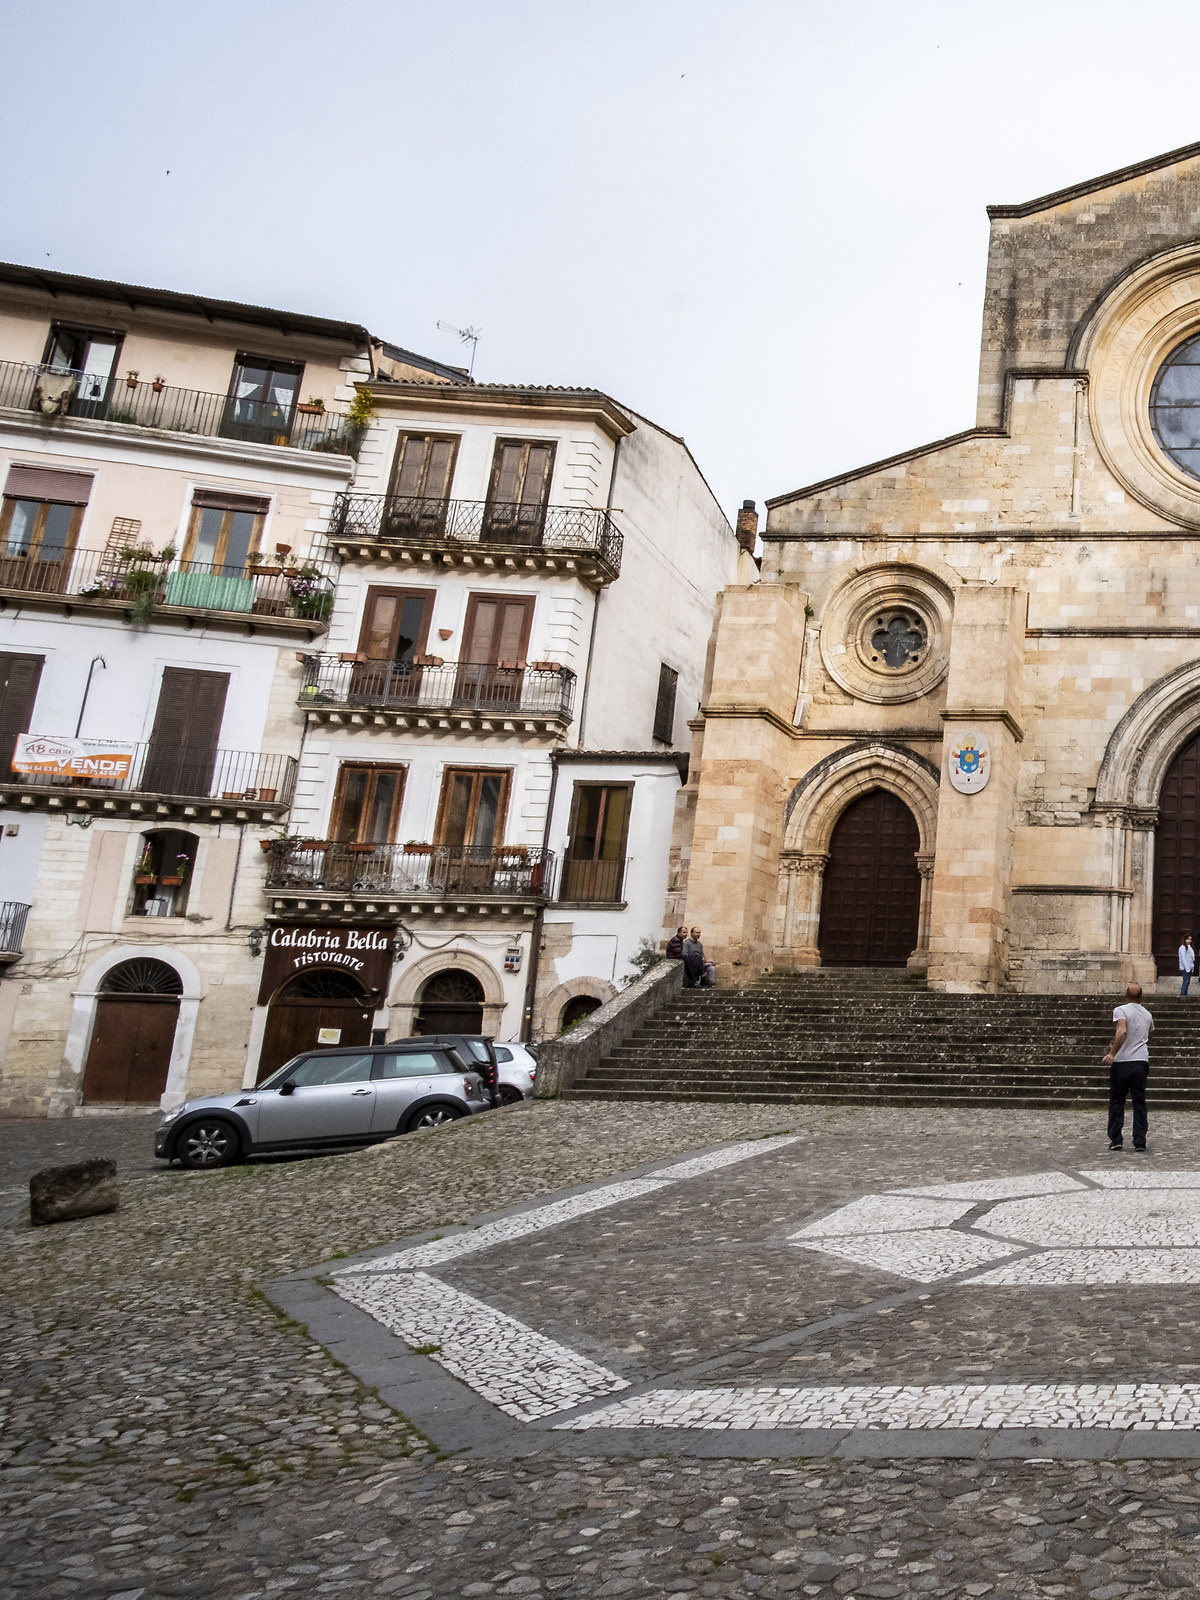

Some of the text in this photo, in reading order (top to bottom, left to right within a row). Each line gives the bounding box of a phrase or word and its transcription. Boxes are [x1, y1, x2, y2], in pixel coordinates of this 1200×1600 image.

[25, 744, 75, 756] AB case
[56, 757, 128, 771] VENDE
[271, 928, 388, 950] Calabria Bella
